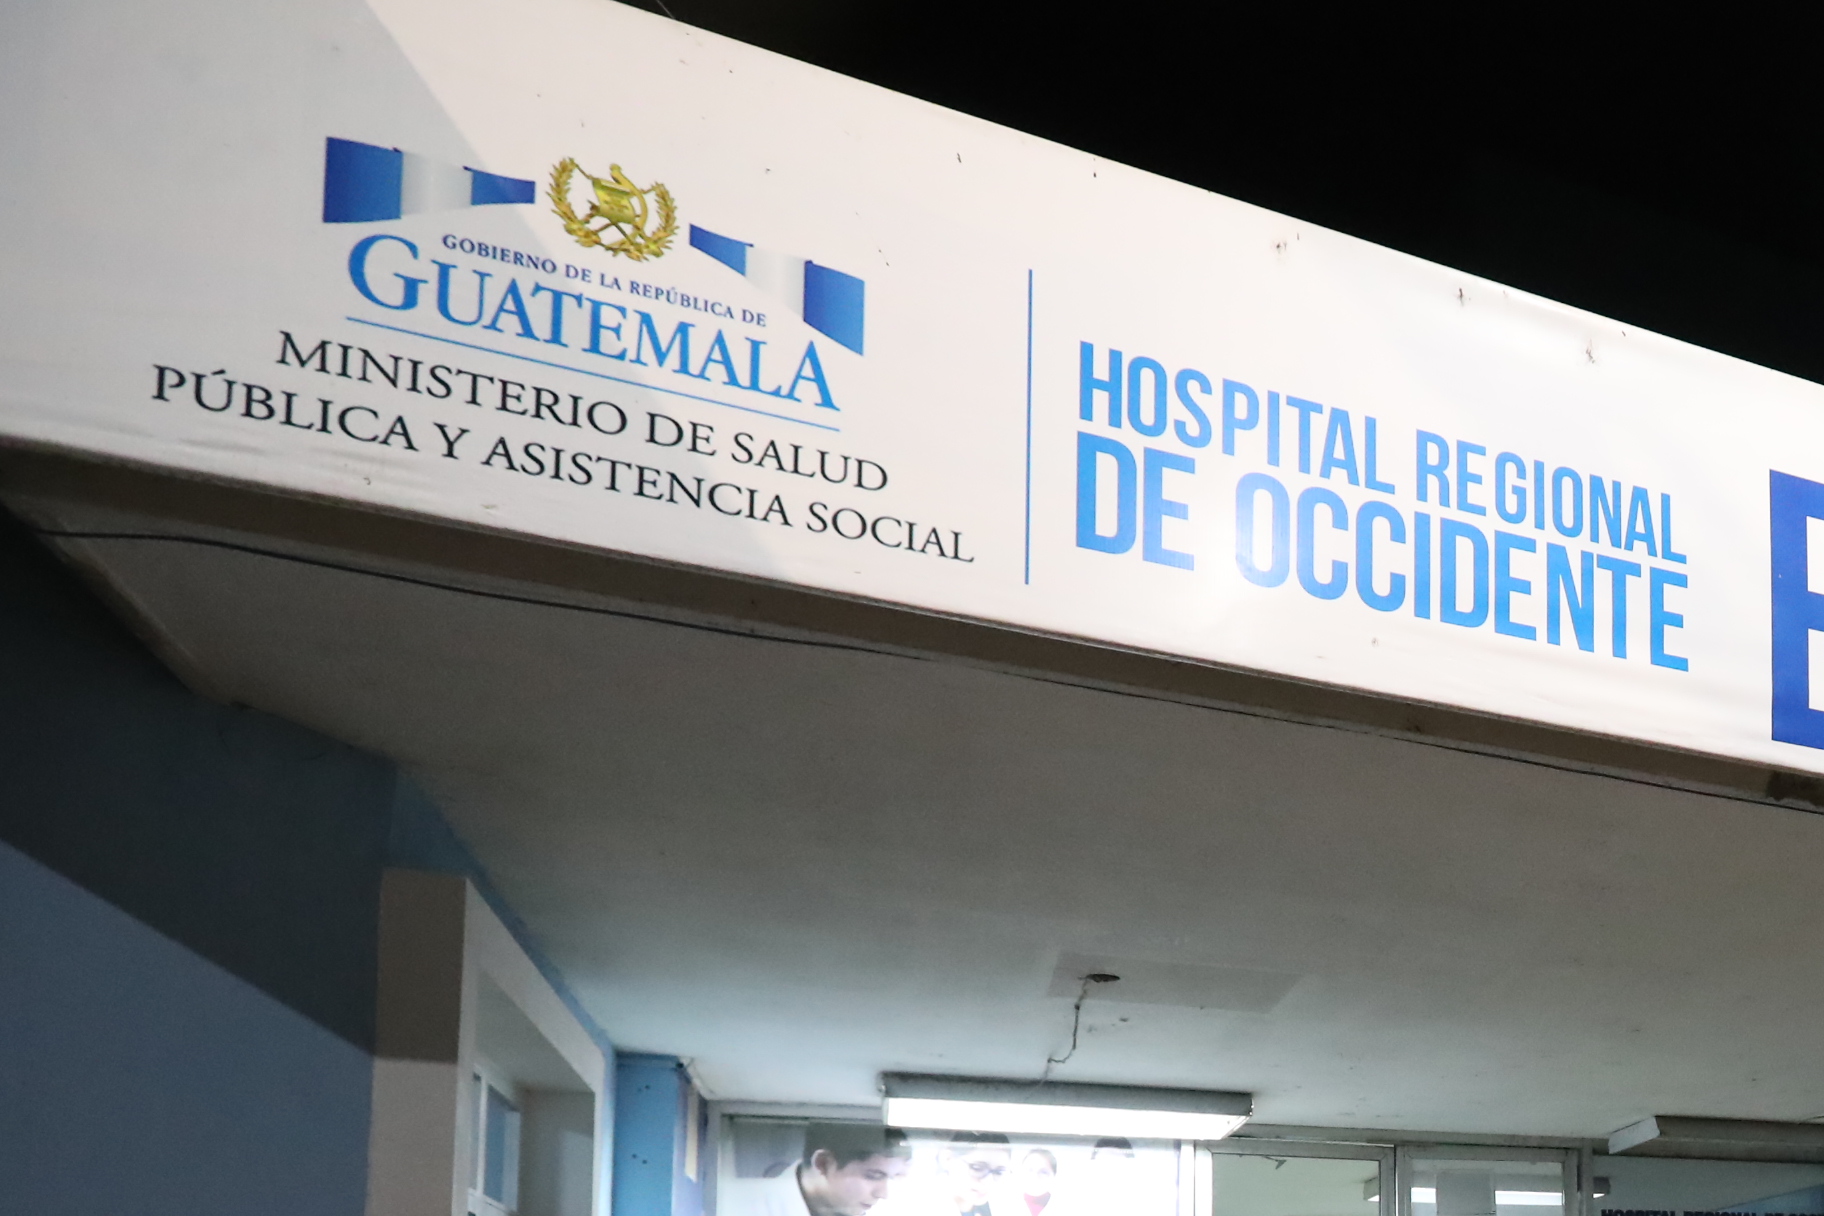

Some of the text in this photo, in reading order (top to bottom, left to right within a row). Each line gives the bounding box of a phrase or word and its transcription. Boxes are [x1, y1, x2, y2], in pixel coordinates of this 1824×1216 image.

[346, 233, 842, 412] GUATEMALA
[441, 233, 768, 328] GOBIERNO DE LA REPÚBLICA DE
[151, 364, 976, 564] PÚBLICA Y ASISTENCIA SOCIAL
[276, 330, 888, 495] MINISTERIO DE SALUD
[1079, 340, 1688, 565] HOSPITAL REGIONAL
[1075, 430, 1689, 673] DE OCCIDENTE
